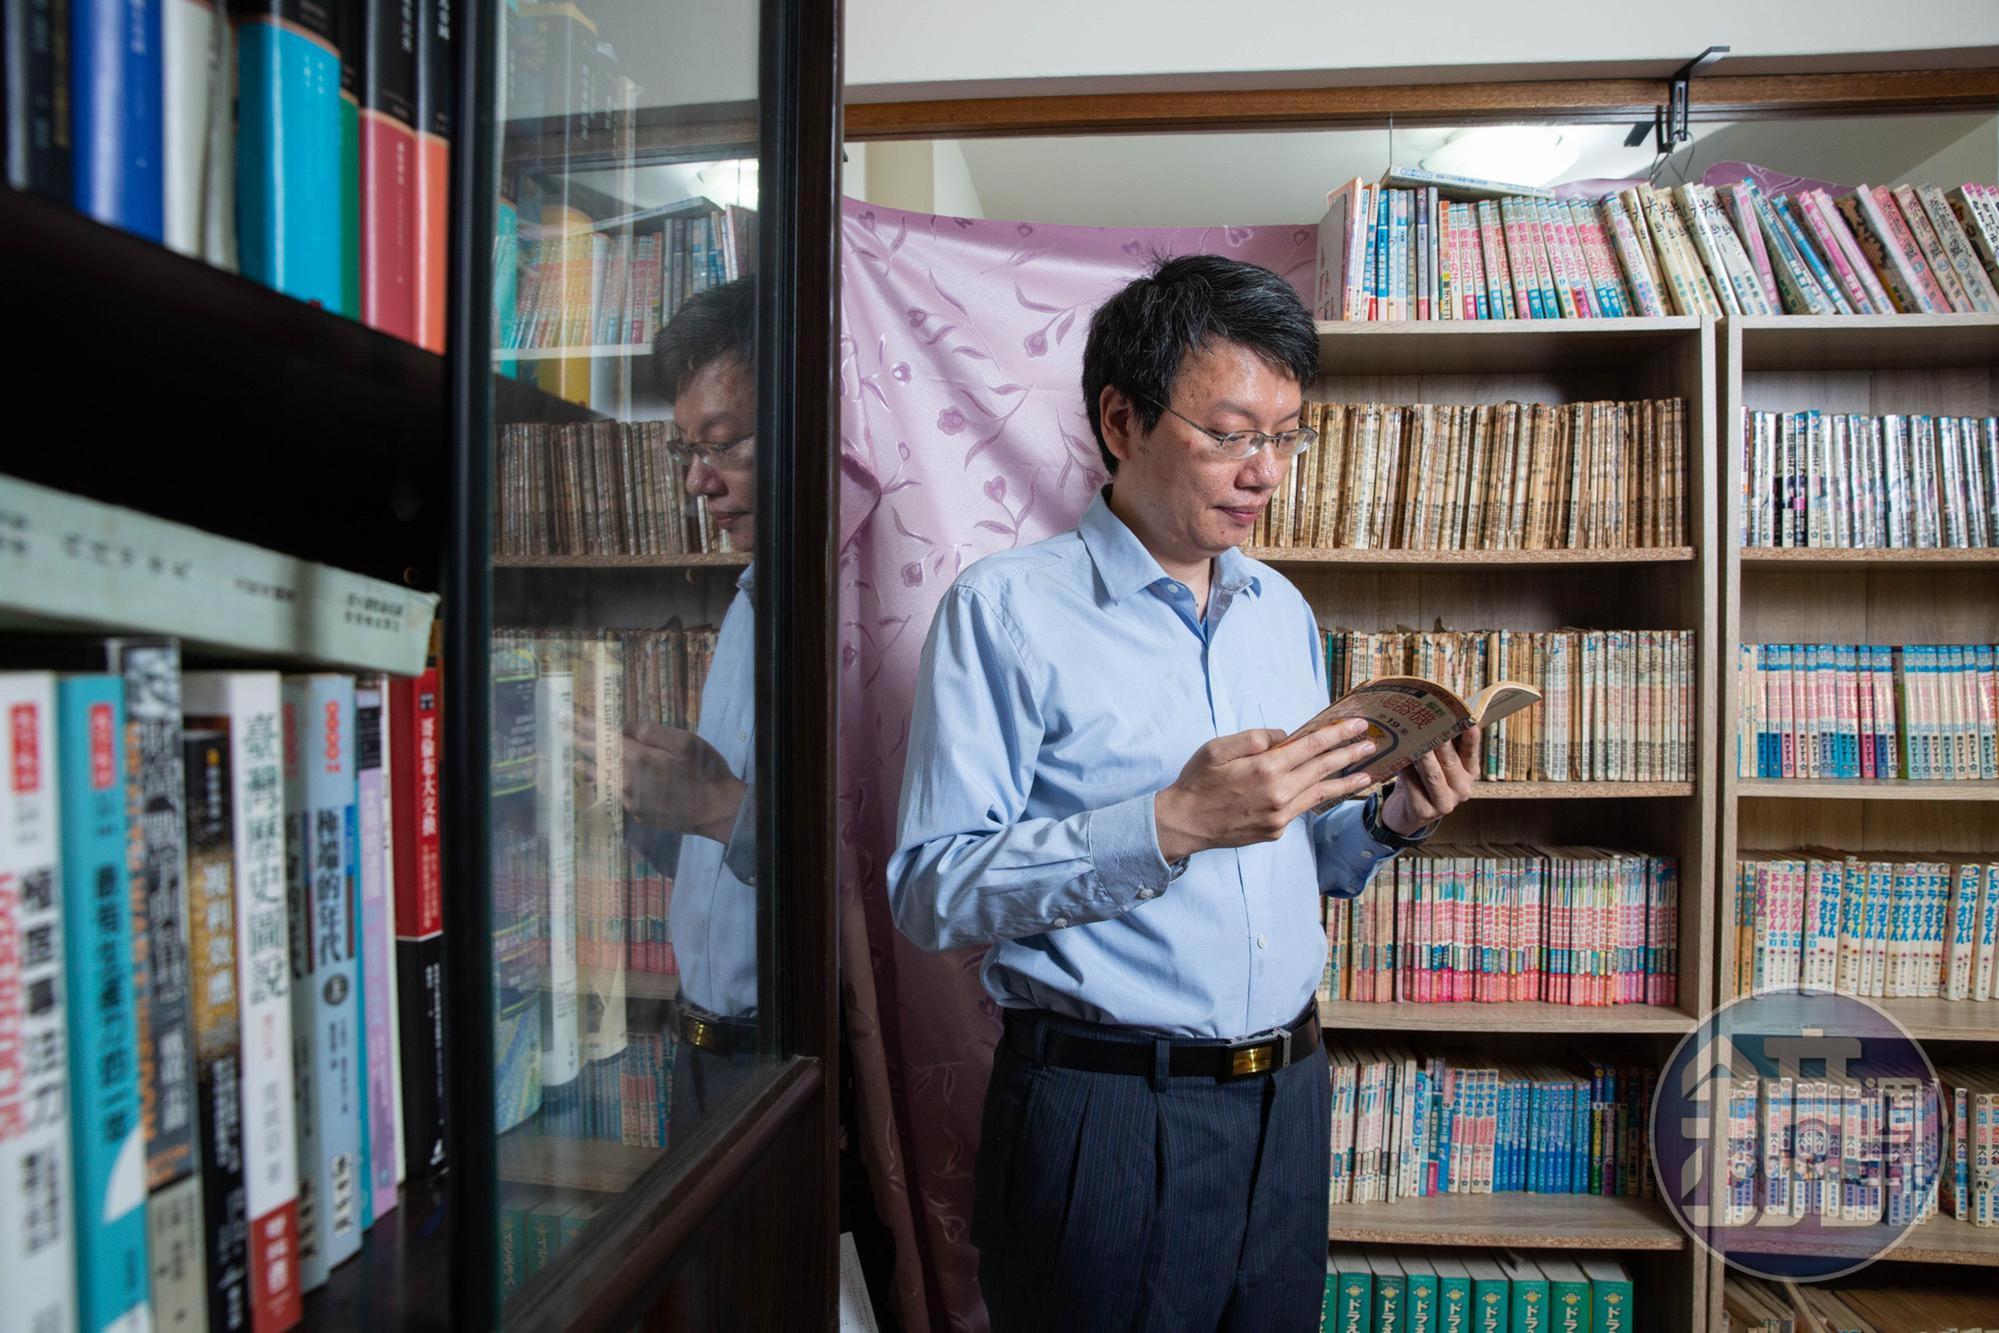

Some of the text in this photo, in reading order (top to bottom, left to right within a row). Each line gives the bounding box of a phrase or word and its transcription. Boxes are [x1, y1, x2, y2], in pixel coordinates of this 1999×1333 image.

[420, 717, 436, 836] 哥倫布大交換
[603, 675, 614, 817] THE BIRTH OF PLENTY
[1769, 873, 1780, 931] ドラえもん
[1779, 873, 1791, 931] ドラえもん
[1792, 873, 1804, 931] ドラえもん
[1807, 873, 1819, 931] ドラえもん
[1819, 872, 1830, 938] ドラえもん
[1828, 873, 1839, 938] ドラえもん
[1842, 868, 1854, 934] ドラえもん
[1851, 874, 1865, 939] ドラえもん
[1865, 874, 1879, 939] ドラえもん
[1877, 874, 1891, 940] ドラえもん
[1890, 876, 1905, 941] ドラえもん
[1900, 876, 1913, 941] ドラえもん
[1912, 876, 1925, 941] ドラえもん
[1923, 876, 1938, 941] ドラえもん
[1934, 876, 1949, 941] ドラえもん
[1956, 879, 1970, 944] ドラえもん
[1984, 880, 1998, 945] ドラえもん
